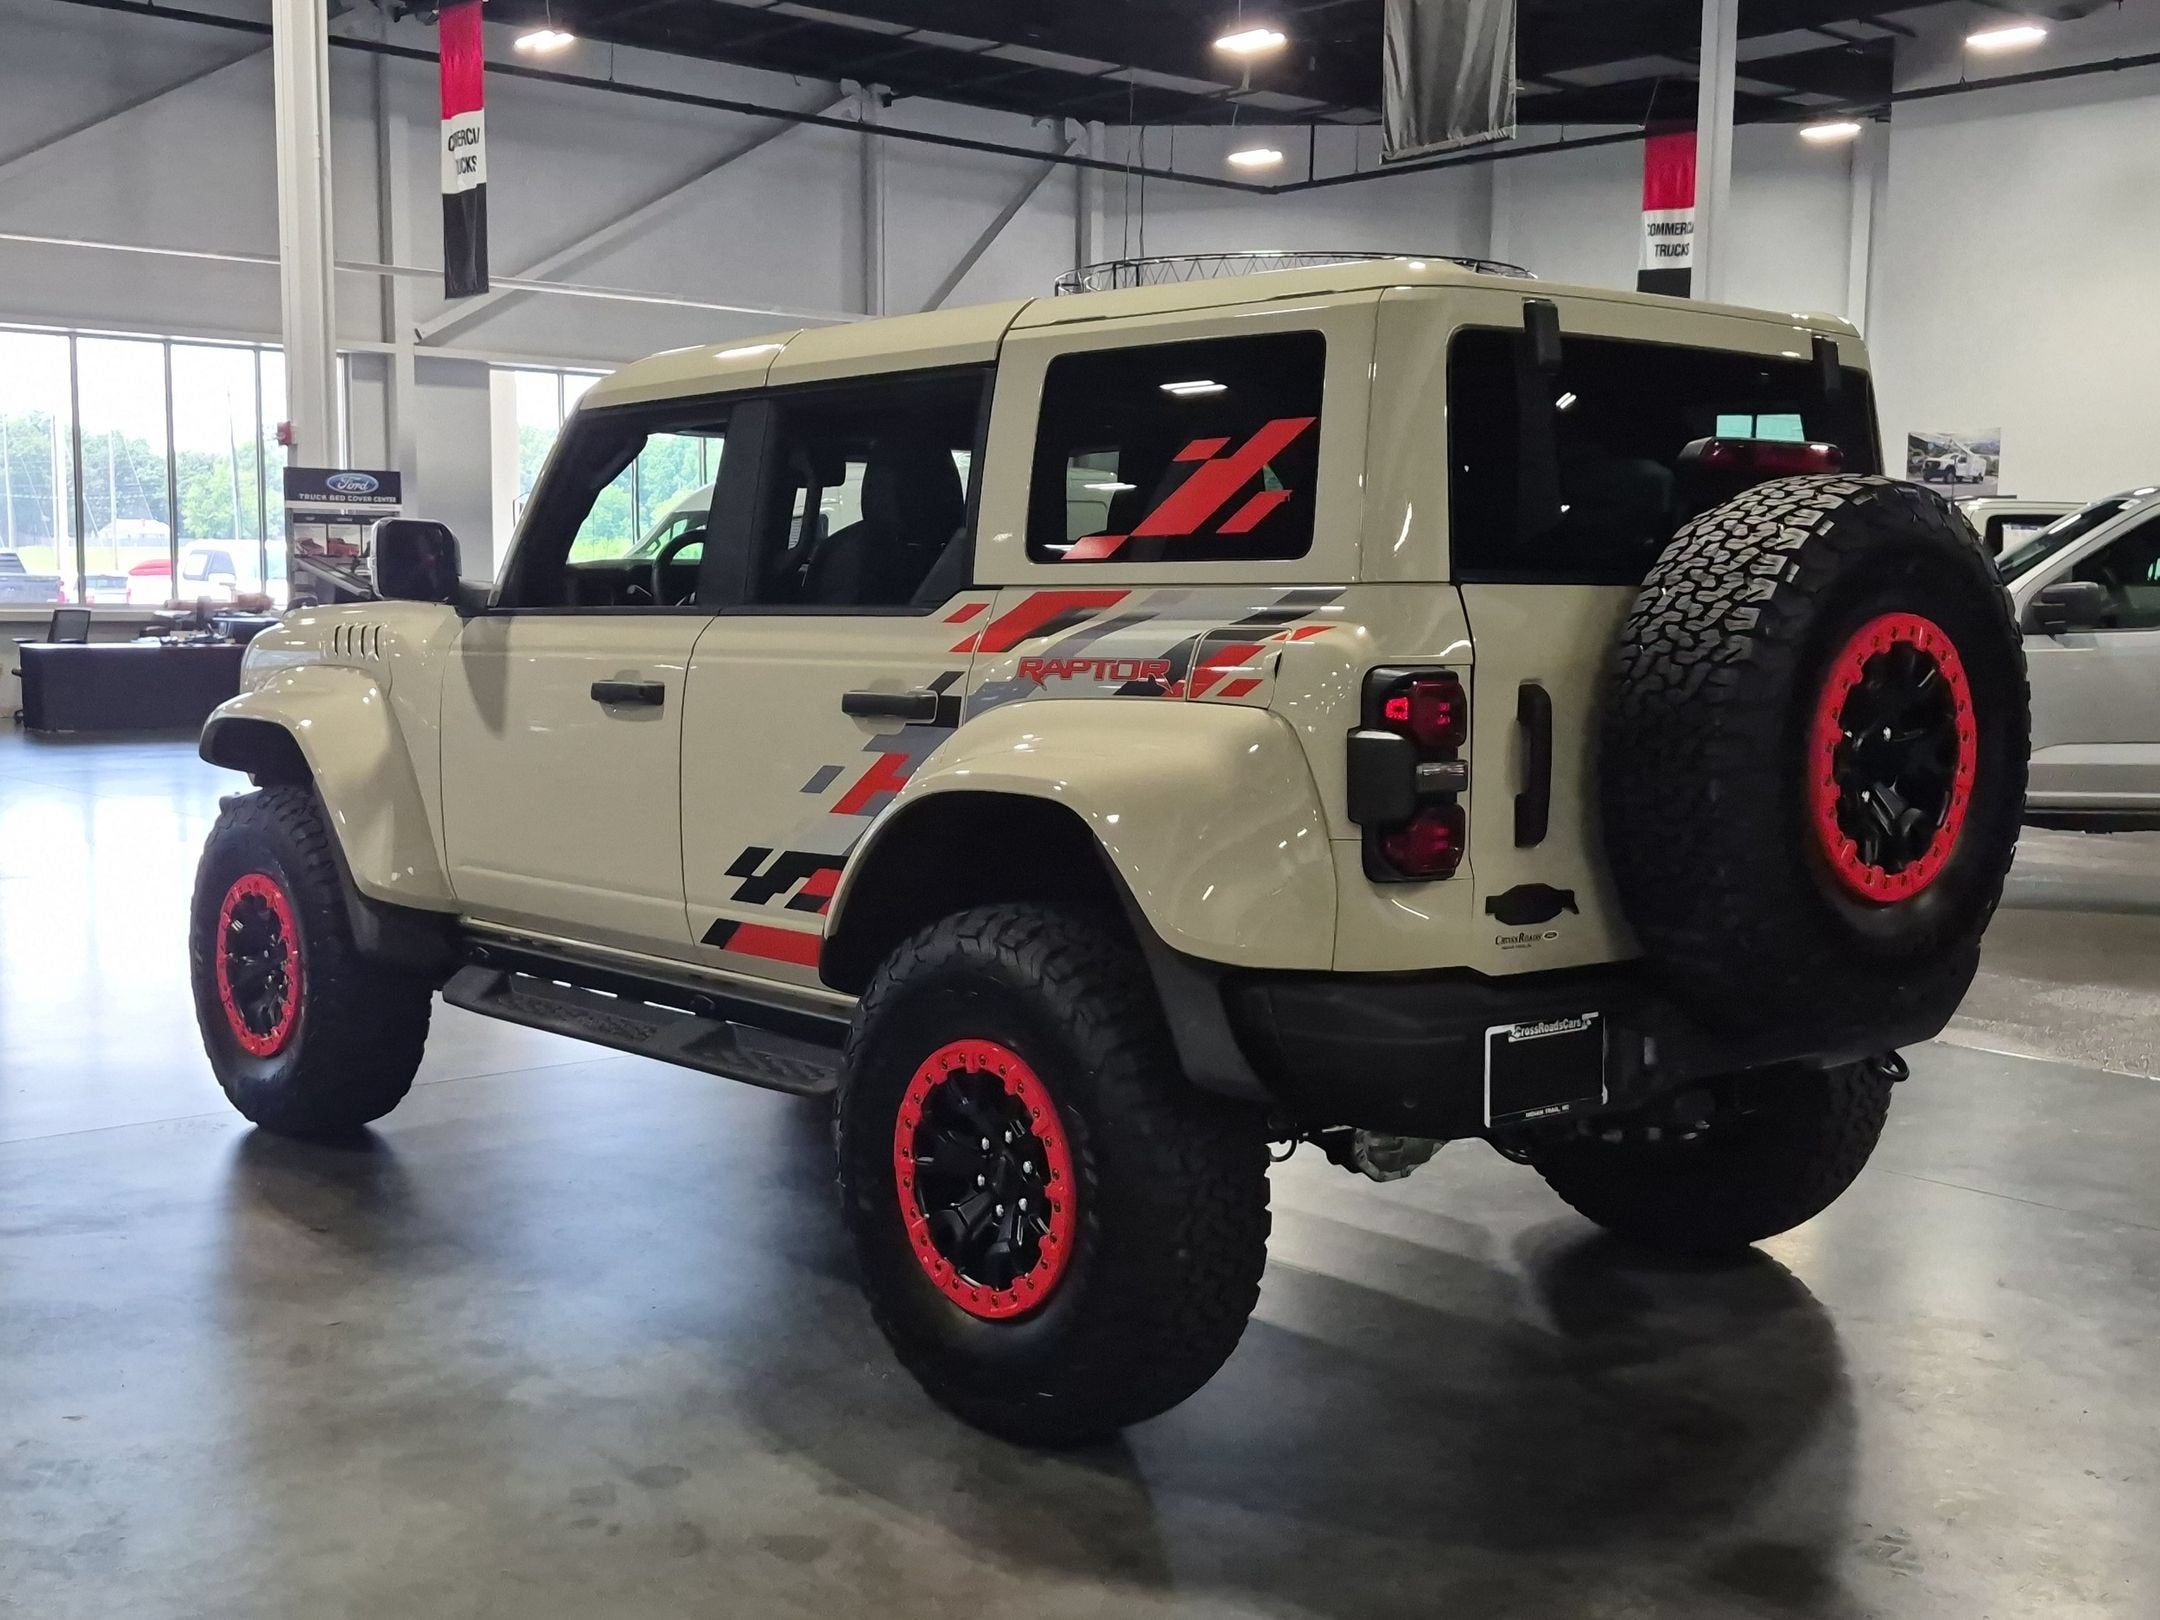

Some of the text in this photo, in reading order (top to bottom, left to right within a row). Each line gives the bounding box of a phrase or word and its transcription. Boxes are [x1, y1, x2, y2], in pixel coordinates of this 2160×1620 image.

[1655, 242, 1690, 257] TRUCKS
[337, 477, 369, 490] Ford
[299, 493, 327, 501] TRUCK
[329, 494, 346, 502] BED
[1018, 656, 1174, 695] RAPTOR
